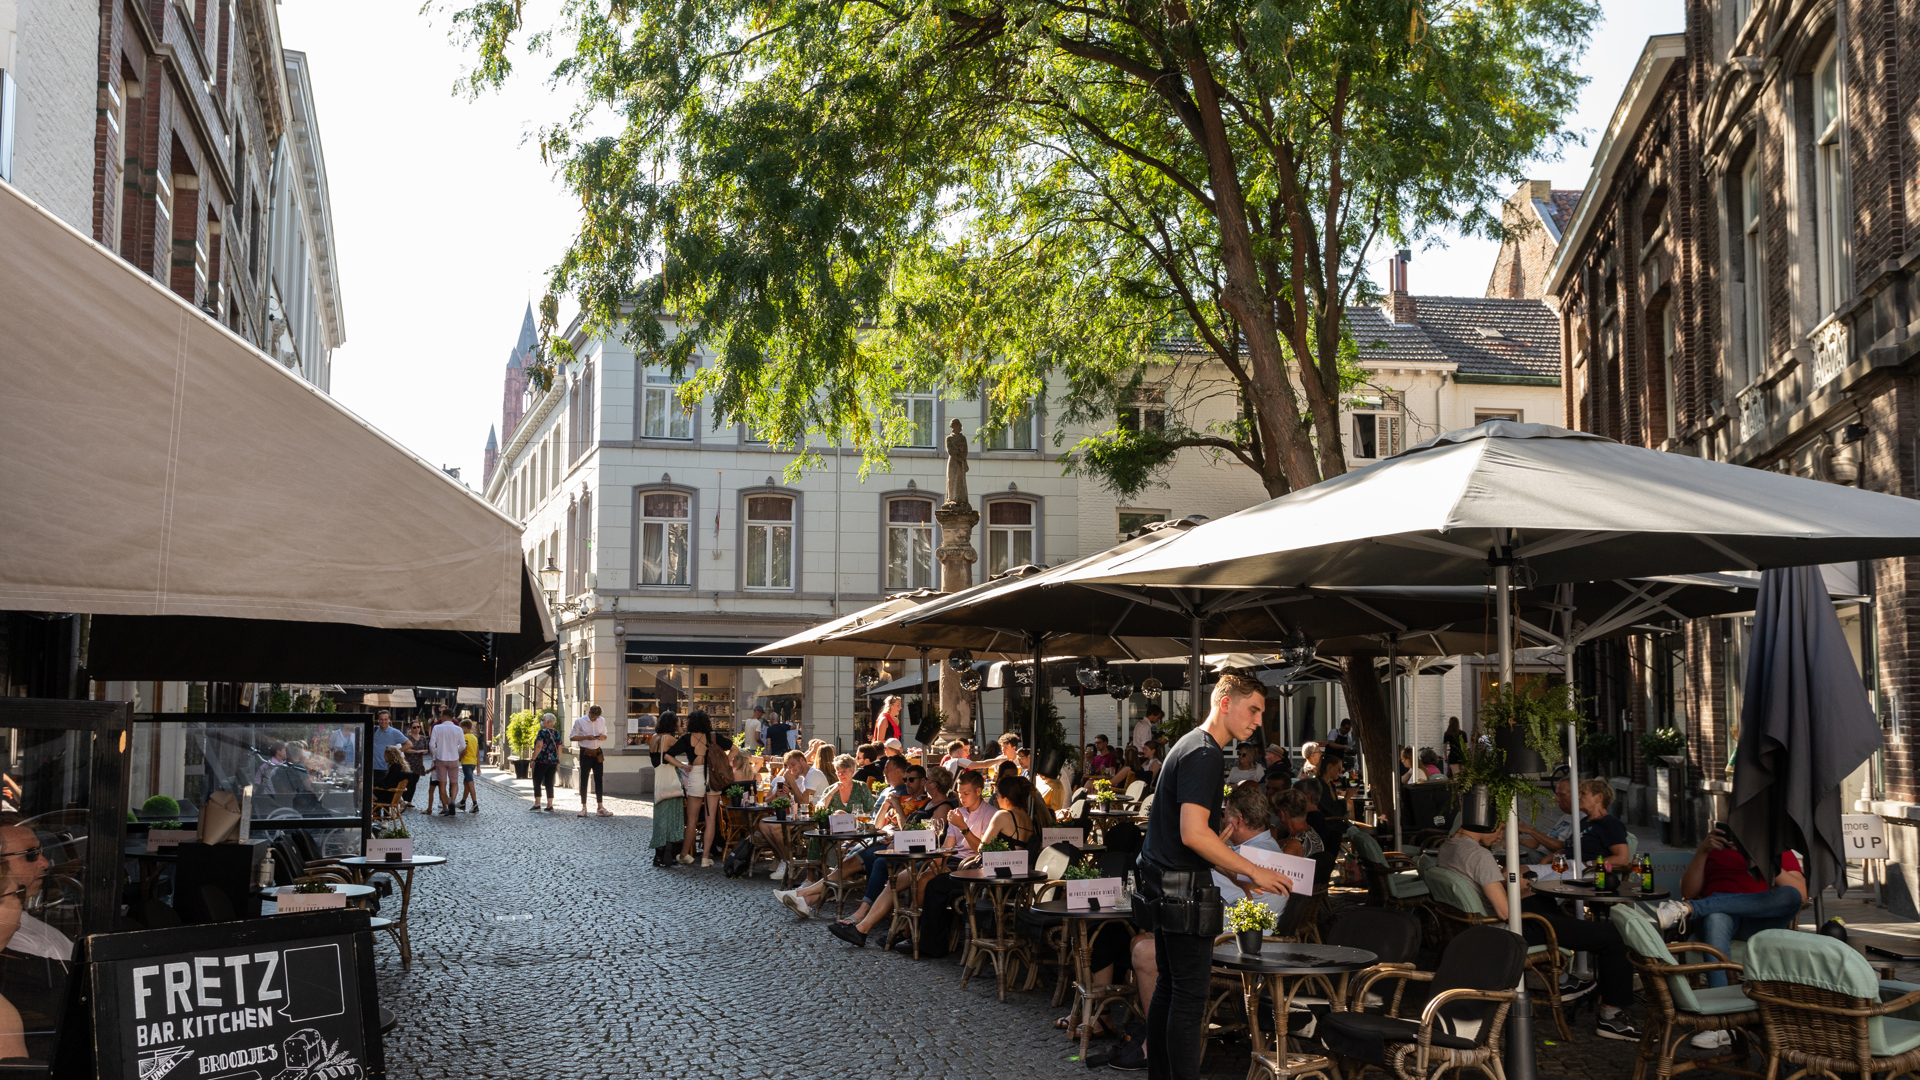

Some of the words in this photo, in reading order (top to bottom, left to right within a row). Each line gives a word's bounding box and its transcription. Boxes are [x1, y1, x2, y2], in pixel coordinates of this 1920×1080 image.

[1844, 823, 1869, 831] more
[1853, 837, 1881, 849] UP
[1287, 870, 1304, 880] DINER
[133, 951, 282, 1019] FRETZ
[198, 1044, 279, 1075] BROODJES
[149, 1058, 176, 1080] UNCH
